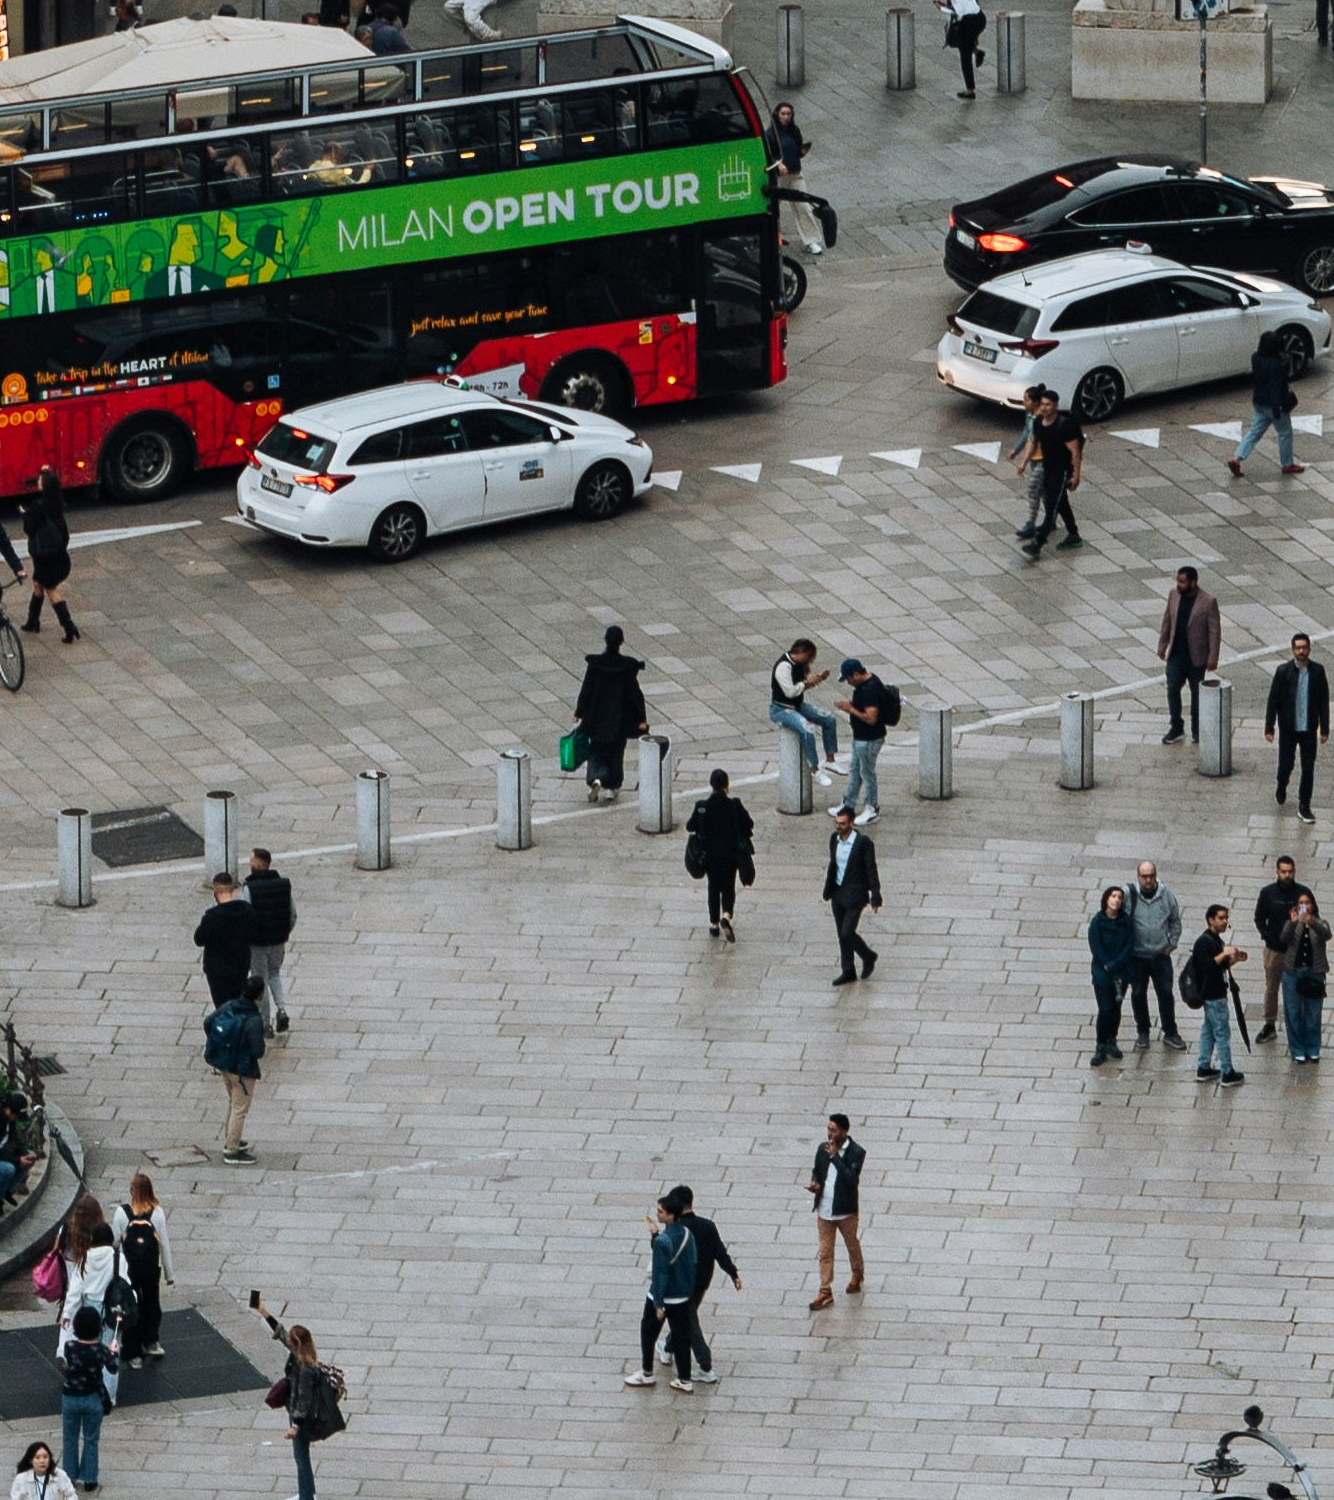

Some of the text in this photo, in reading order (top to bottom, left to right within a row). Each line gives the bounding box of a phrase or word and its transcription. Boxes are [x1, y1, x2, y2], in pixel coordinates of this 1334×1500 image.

[338, 173, 700, 253] MILAN OPEN TOUR
[431, 316, 457, 329] relax
[459, 311, 479, 326] and
[481, 311, 502, 323] save
[527, 303, 549, 318] time
[35, 370, 58, 385] take
[66, 366, 89, 383] trip
[103, 361, 118, 376] the
[120, 356, 167, 374] HEART
[169, 352, 180, 367] of
[492, 381, 509, 391] 72h
